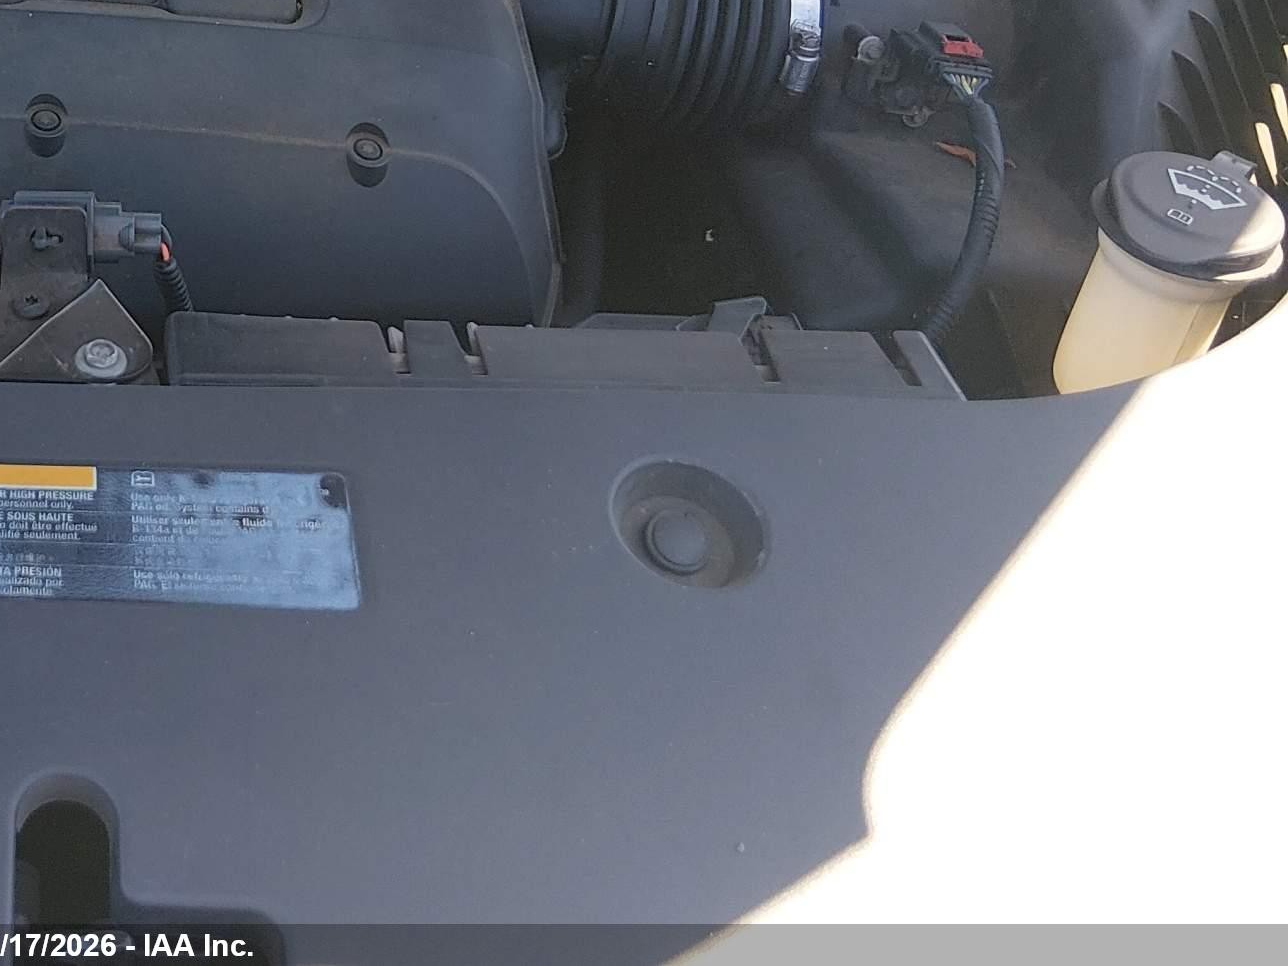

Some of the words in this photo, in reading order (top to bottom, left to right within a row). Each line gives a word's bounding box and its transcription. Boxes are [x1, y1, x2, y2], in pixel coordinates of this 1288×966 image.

[9, 490, 35, 499] HIGH
[38, 490, 94, 501] PRESSURE
[50, 500, 74, 510] only.
[7, 511, 36, 521] SOUS
[38, 513, 73, 522] HAUTE
[9, 521, 28, 530] doit
[23, 531, 81, 540] seulement.
[14, 564, 62, 577] PRESIÓN
